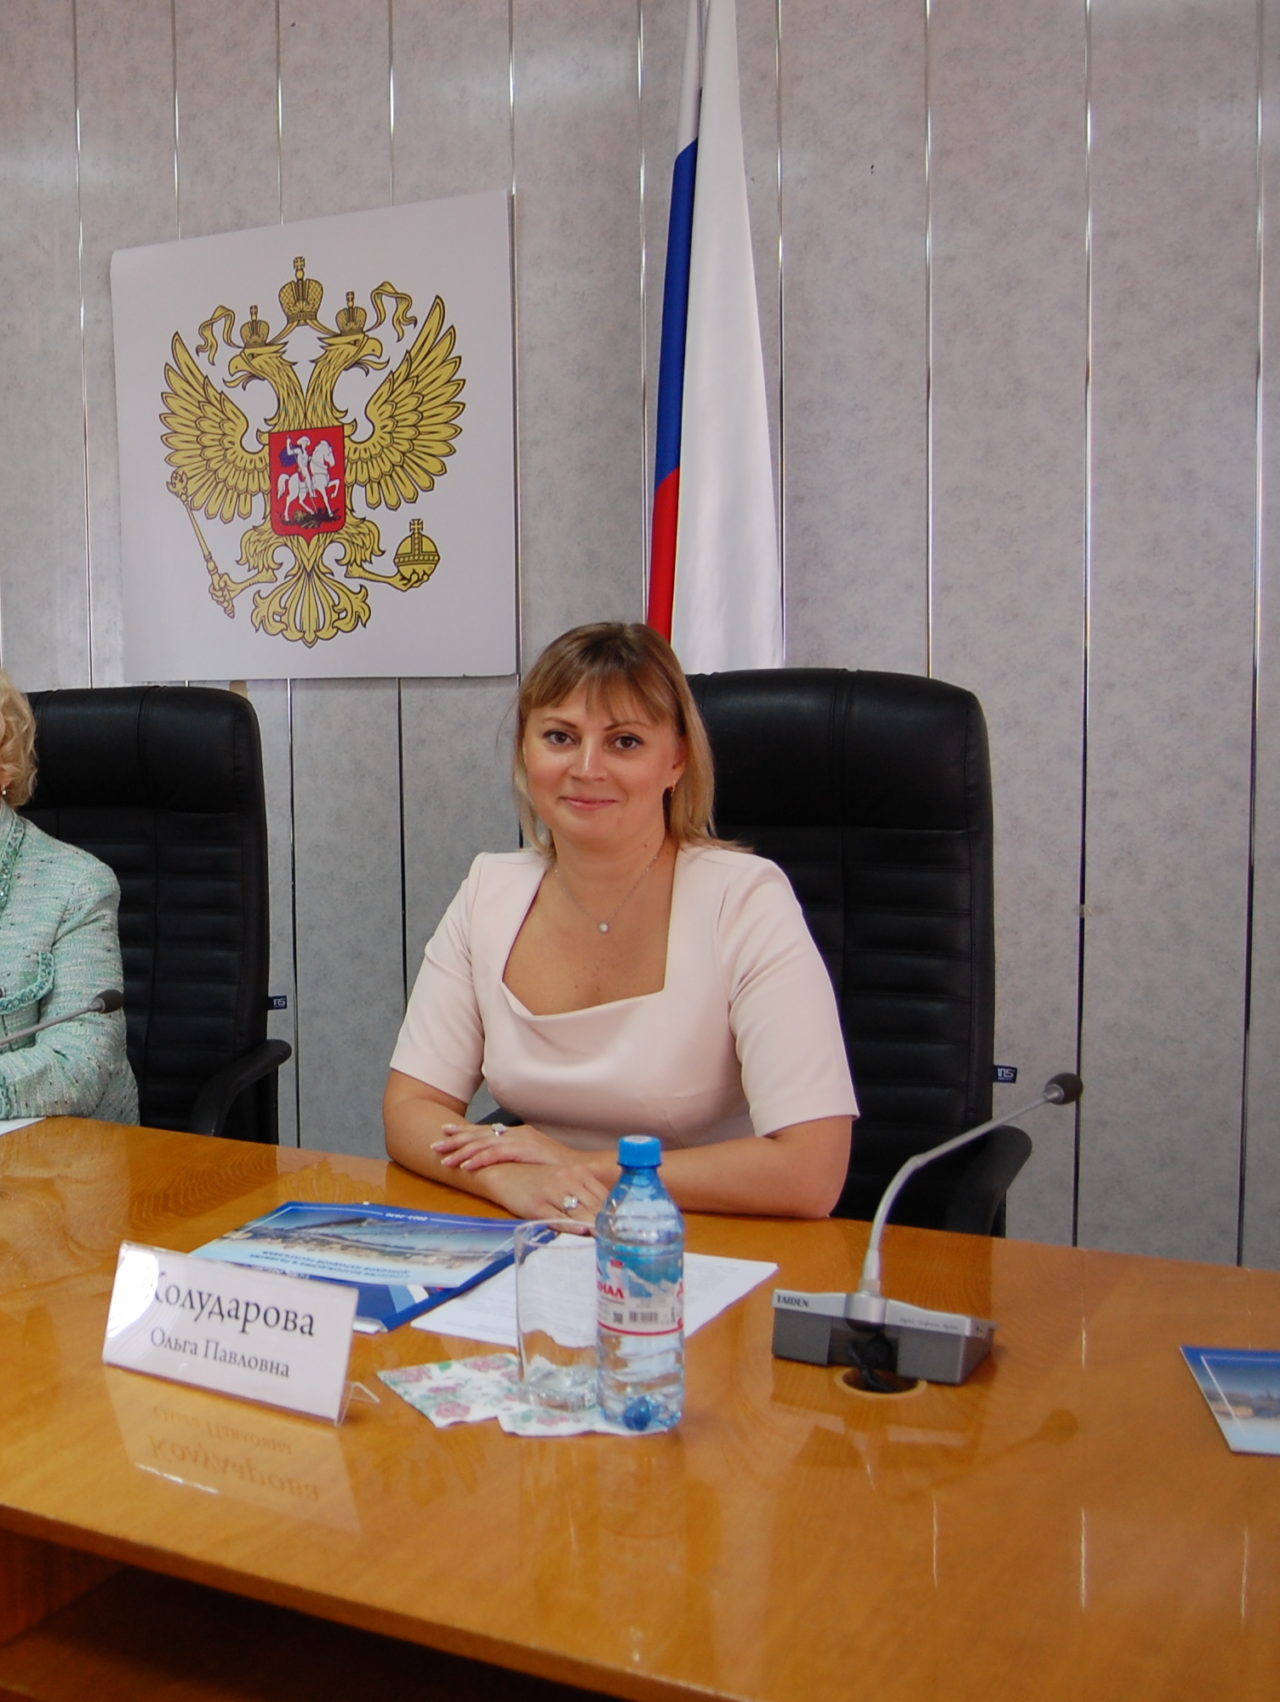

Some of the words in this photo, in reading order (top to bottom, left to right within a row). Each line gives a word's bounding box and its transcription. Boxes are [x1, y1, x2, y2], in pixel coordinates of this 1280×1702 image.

[777, 1295, 810, 1308] TAIDEN
[150, 1327, 199, 1357] Ольга
[202, 1339, 291, 1378] Павловна
